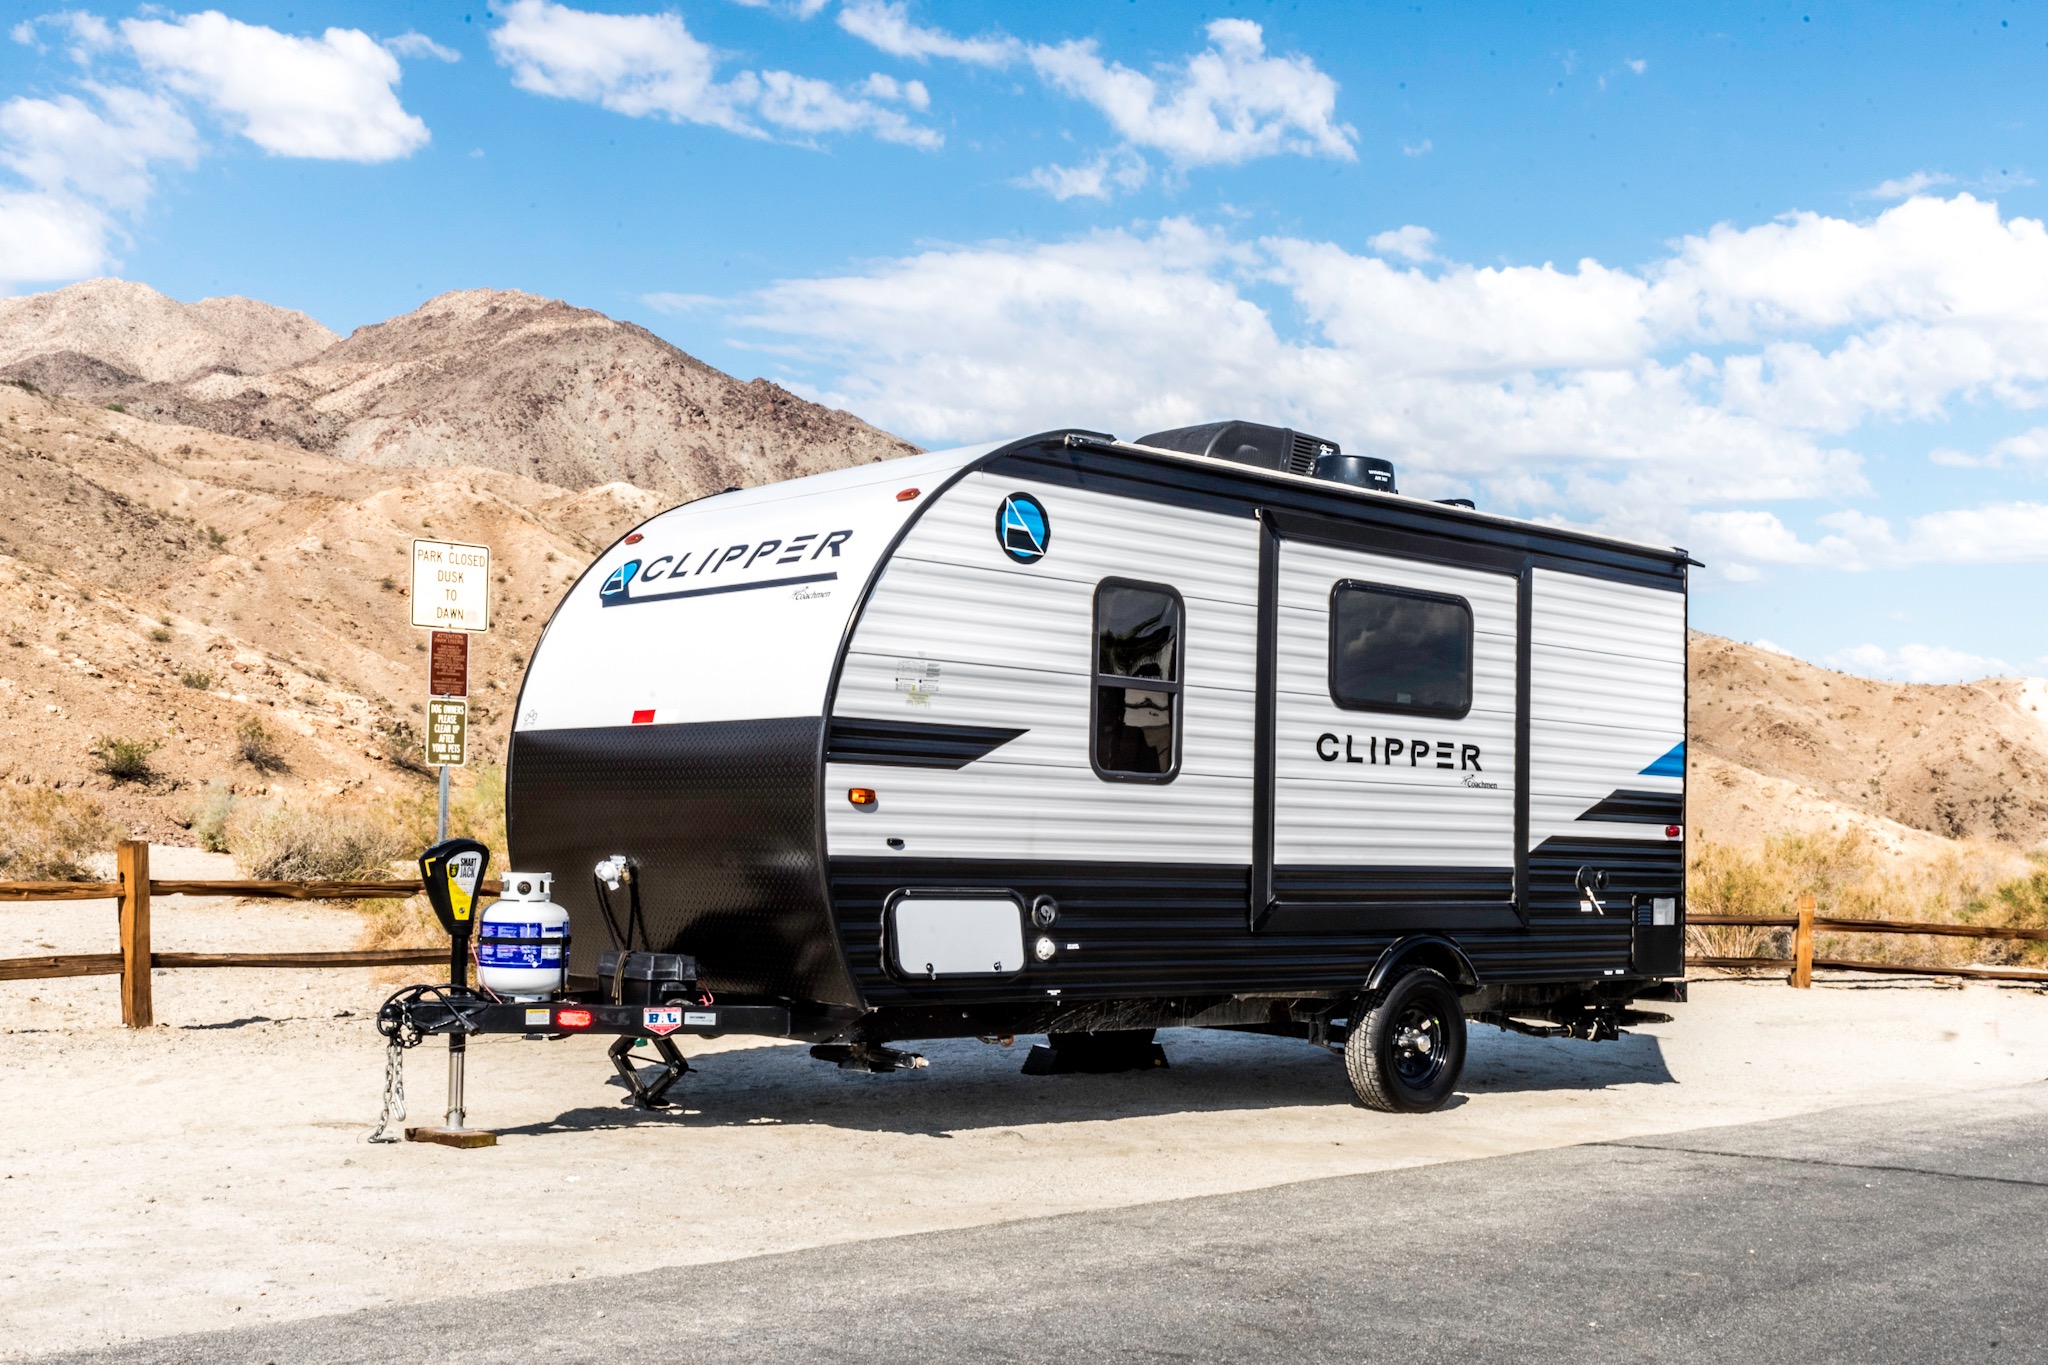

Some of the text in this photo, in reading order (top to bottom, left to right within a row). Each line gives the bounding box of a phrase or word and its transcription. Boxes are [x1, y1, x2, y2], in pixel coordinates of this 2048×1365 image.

[418, 549, 485, 567] PARK CLOSED
[641, 529, 853, 582] CLIPPER
[437, 570, 464, 583] DUSK
[445, 589, 457, 601] TO
[437, 607, 464, 620] DAWN
[431, 704, 464, 715] DOG OWNERS
[437, 714, 458, 724] PLEASE
[434, 724, 460, 734] CLEAN UP
[438, 734, 455, 744] AFTER
[432, 743, 461, 754] YOUR PETS
[1316, 733, 1482, 771] CLIPPER
[1467, 781, 1498, 789] Coachmen
[460, 857, 477, 867] SMART
[460, 866, 476, 878] JACK
[648, 1013, 677, 1023] BL
